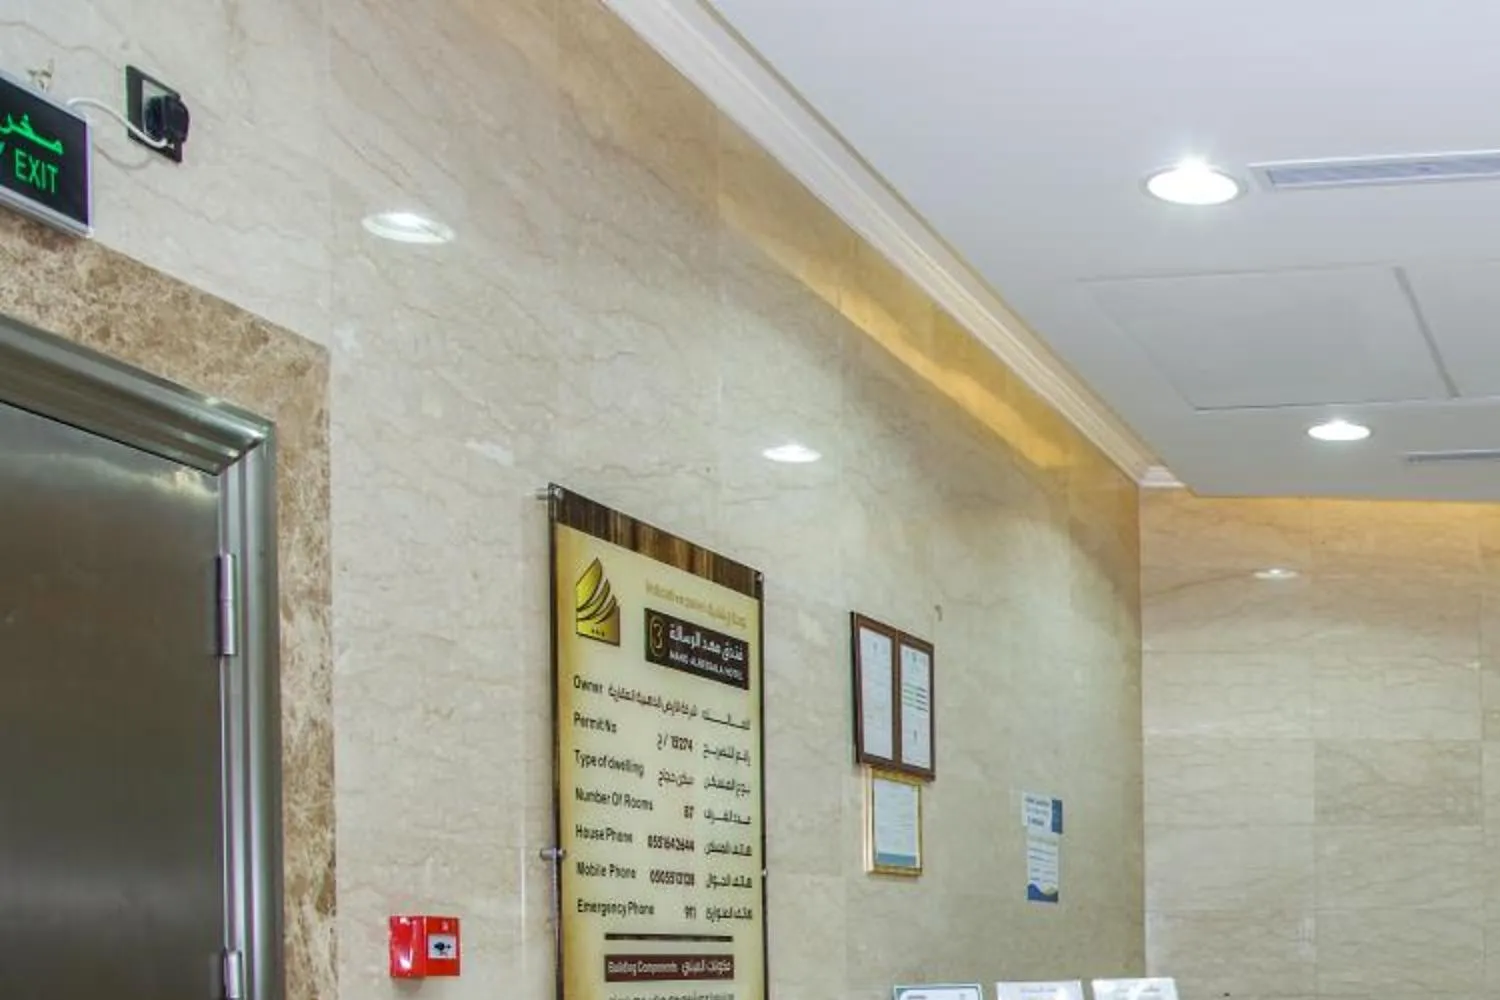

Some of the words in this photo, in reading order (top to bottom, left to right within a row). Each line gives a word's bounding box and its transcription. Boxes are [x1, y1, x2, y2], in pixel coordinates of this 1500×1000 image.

[15, 147, 59, 194] EXIT
[669, 623, 701, 649] الرسالة
[722, 642, 743, 661] فندق
[574, 675, 602, 693] Owner
[574, 749, 597, 769] Type
[608, 756, 644, 779] dwelling
[575, 787, 611, 805] Number
[624, 793, 653, 811] Rooms
[575, 823, 605, 841] House
[605, 827, 633, 843] Phone
[576, 861, 607, 877] Mobile
[609, 863, 636, 879] Phone
[731, 874, 752, 889] هاتف
[577, 898, 627, 918] Emergency
[628, 900, 655, 916] Phone
[733, 905, 752, 919] هاتف
